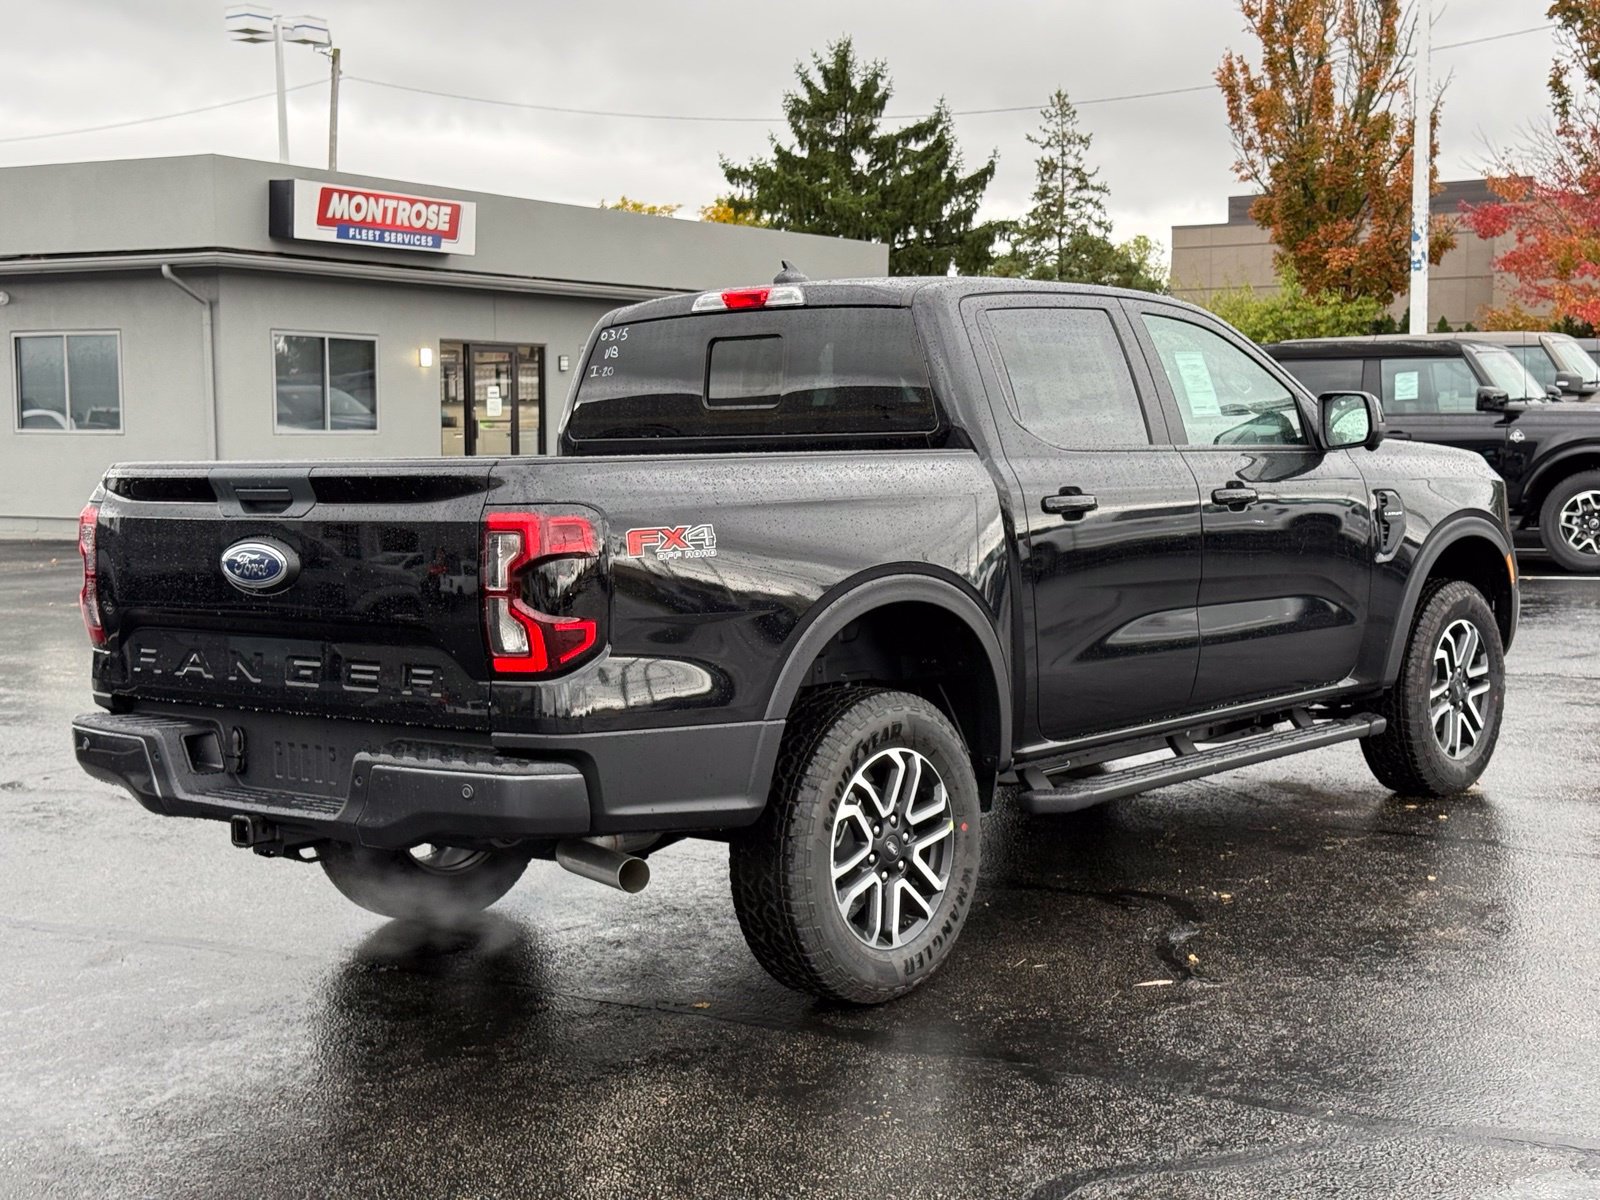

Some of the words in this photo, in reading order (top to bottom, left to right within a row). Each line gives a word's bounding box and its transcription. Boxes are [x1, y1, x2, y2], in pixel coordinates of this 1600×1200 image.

[326, 192, 452, 232] MONTROSE
[349, 227, 381, 241] FLEET
[384, 231, 433, 247] SERVICES
[600, 327, 629, 341] 0315
[626, 524, 716, 558] FX4
[657, 551, 682, 560] OFF
[685, 548, 717, 558] ROAD
[232, 552, 269, 576] Ford
[132, 646, 443, 698] RANGER
[823, 720, 903, 832] GOODYEAR
[903, 866, 974, 976] WRANGLER
